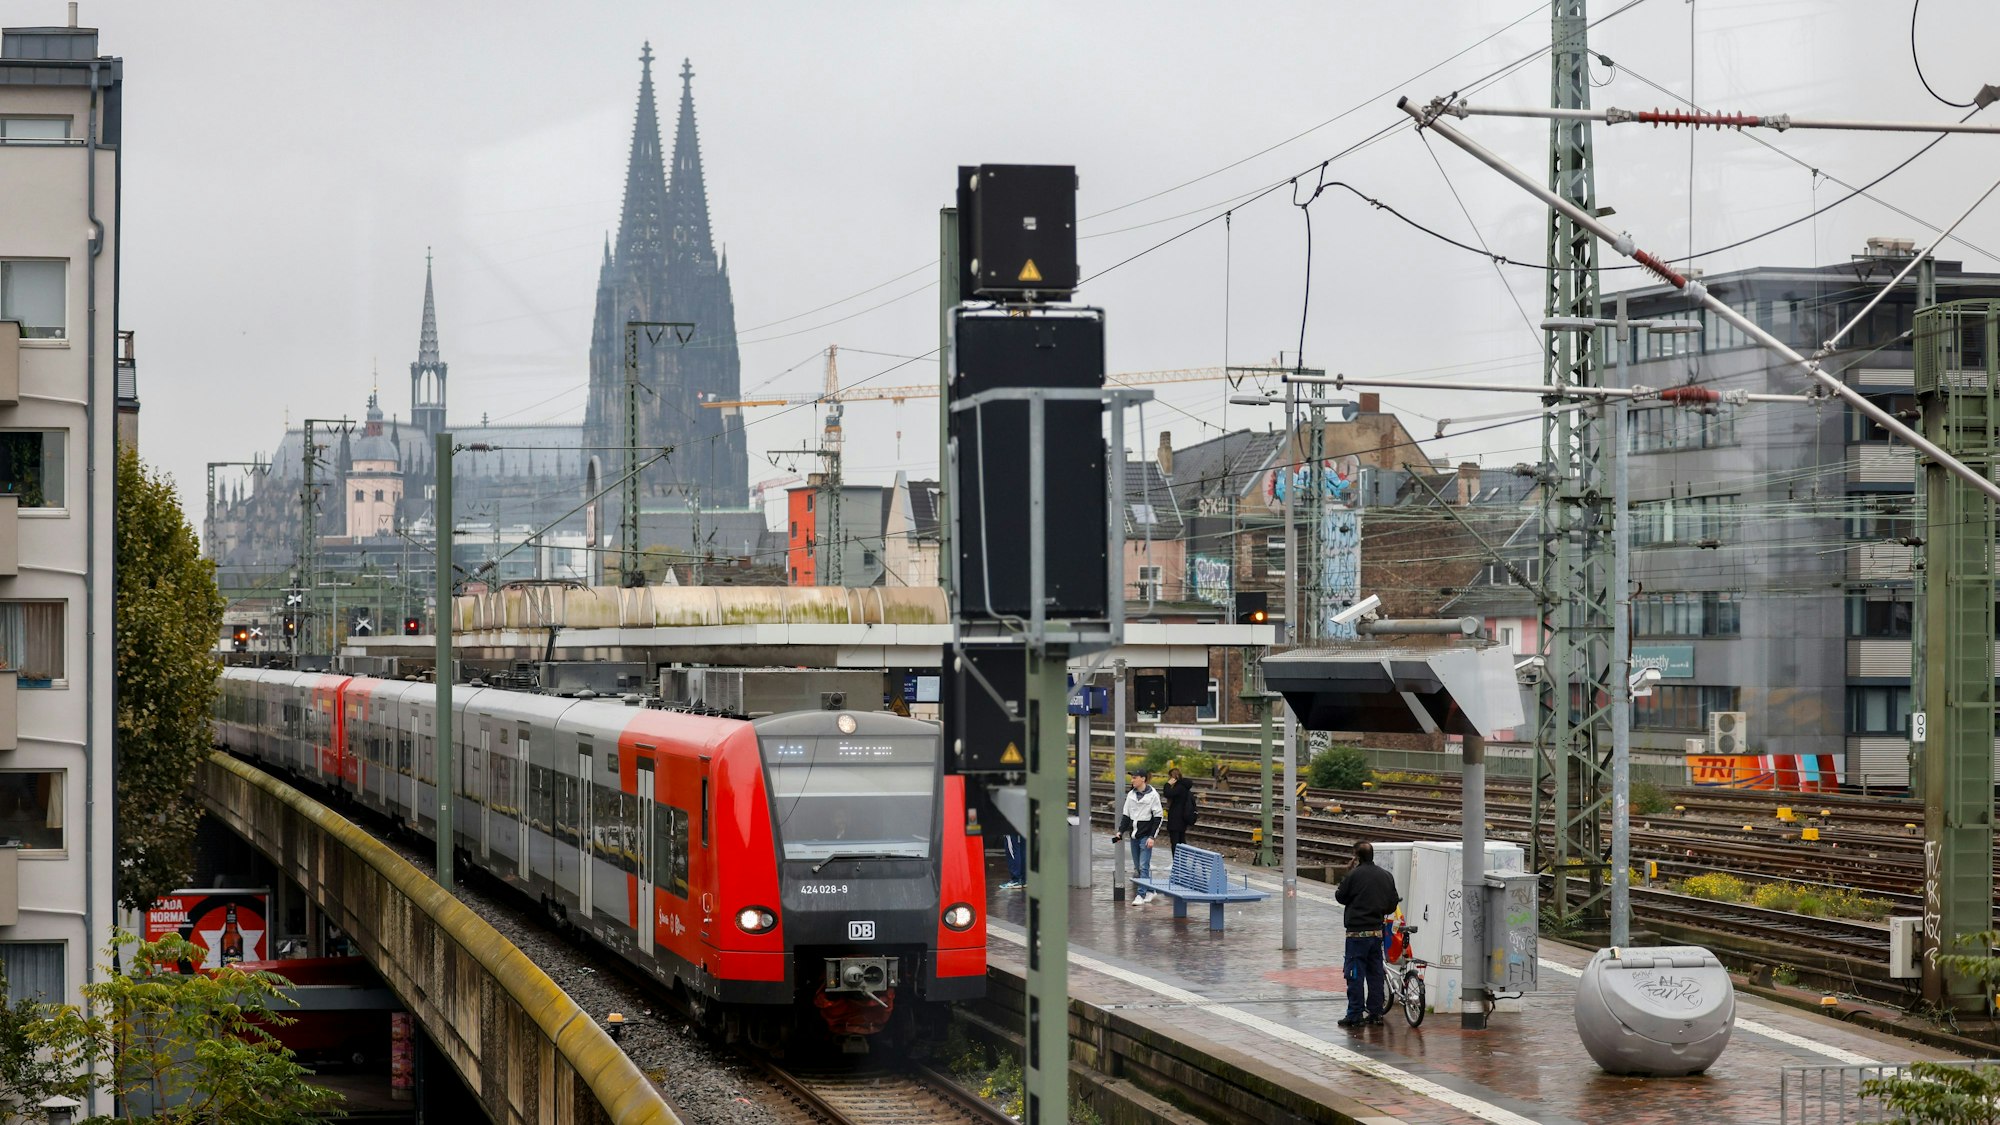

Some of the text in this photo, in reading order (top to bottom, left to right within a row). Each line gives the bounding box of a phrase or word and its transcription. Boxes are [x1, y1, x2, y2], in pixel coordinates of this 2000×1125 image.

[800, 884, 848, 894] 424 028-9
[150, 911, 191, 923] NORMAL
[850, 922, 874, 939] DB
